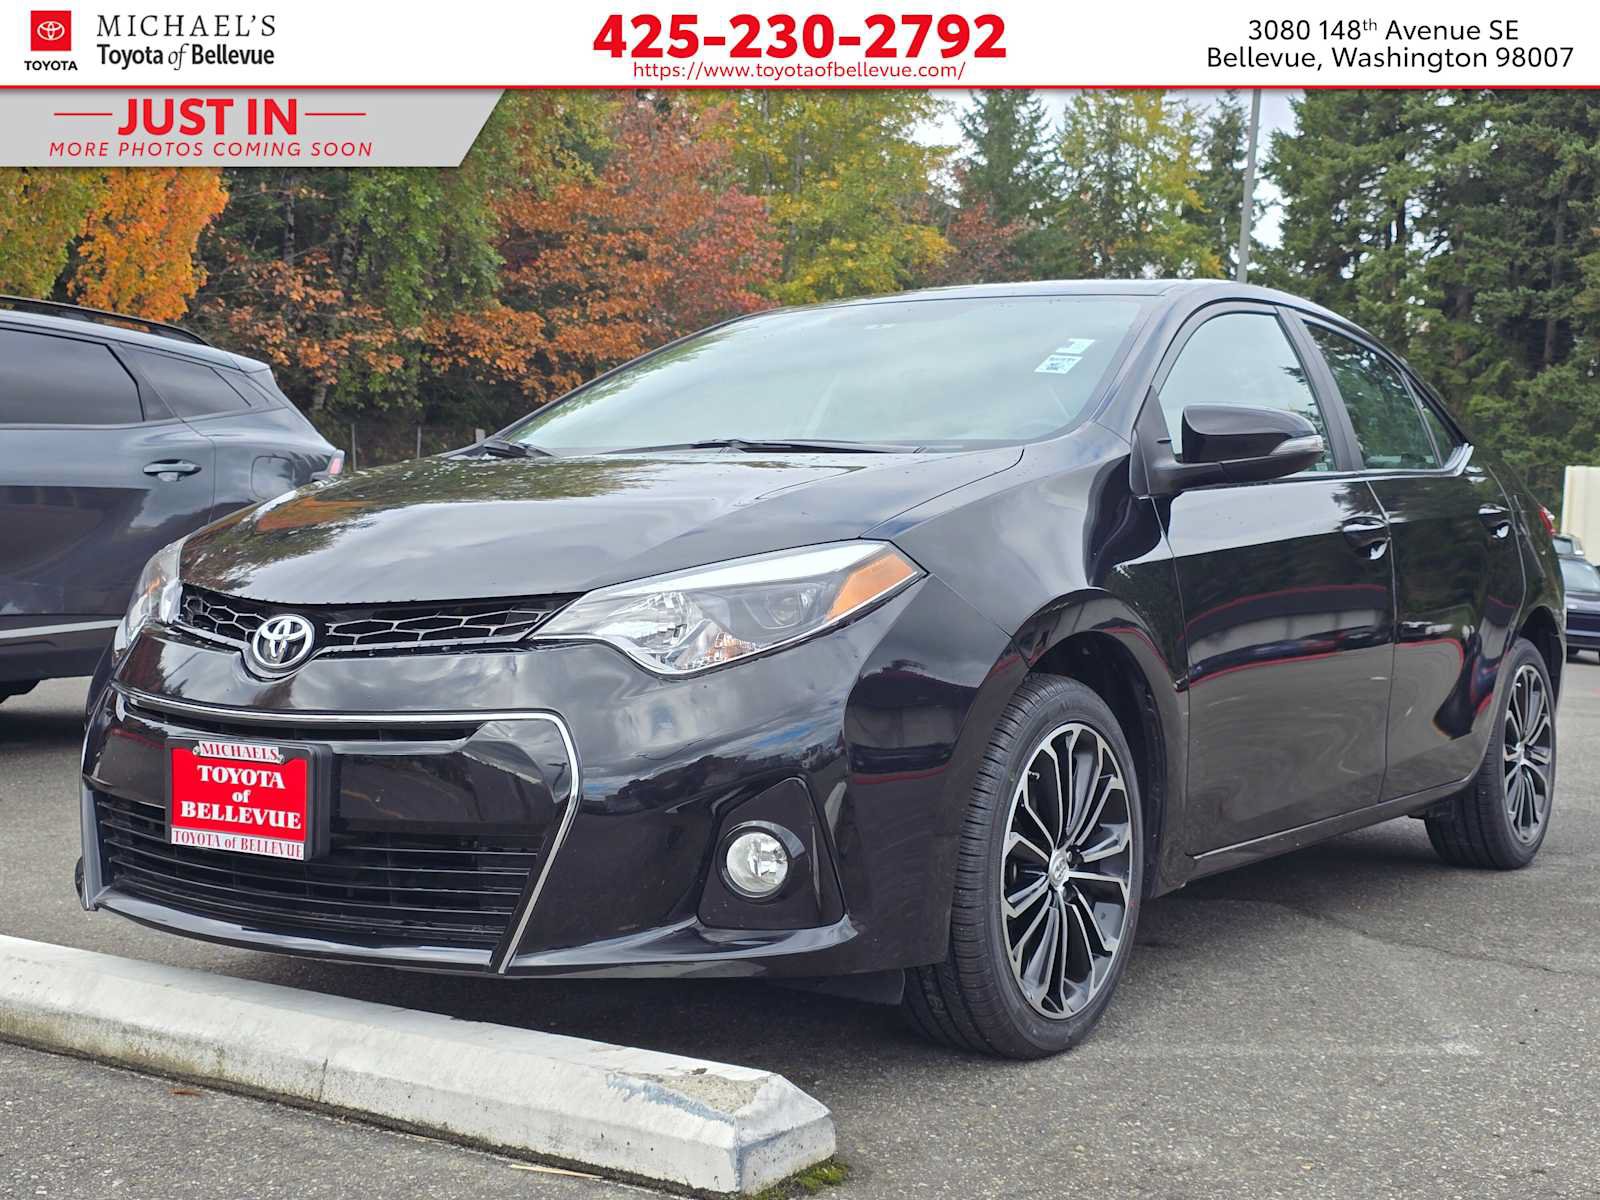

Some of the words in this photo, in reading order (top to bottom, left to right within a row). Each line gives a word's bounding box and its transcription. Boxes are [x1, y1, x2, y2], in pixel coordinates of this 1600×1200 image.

[197, 765, 285, 789] TOYOTA
[232, 790, 251, 803] of
[180, 801, 302, 829] BELLEVUE
[173, 830, 220, 848] TOYOTA
[224, 837, 237, 849] of
[240, 838, 303, 858] BELLEVUE
